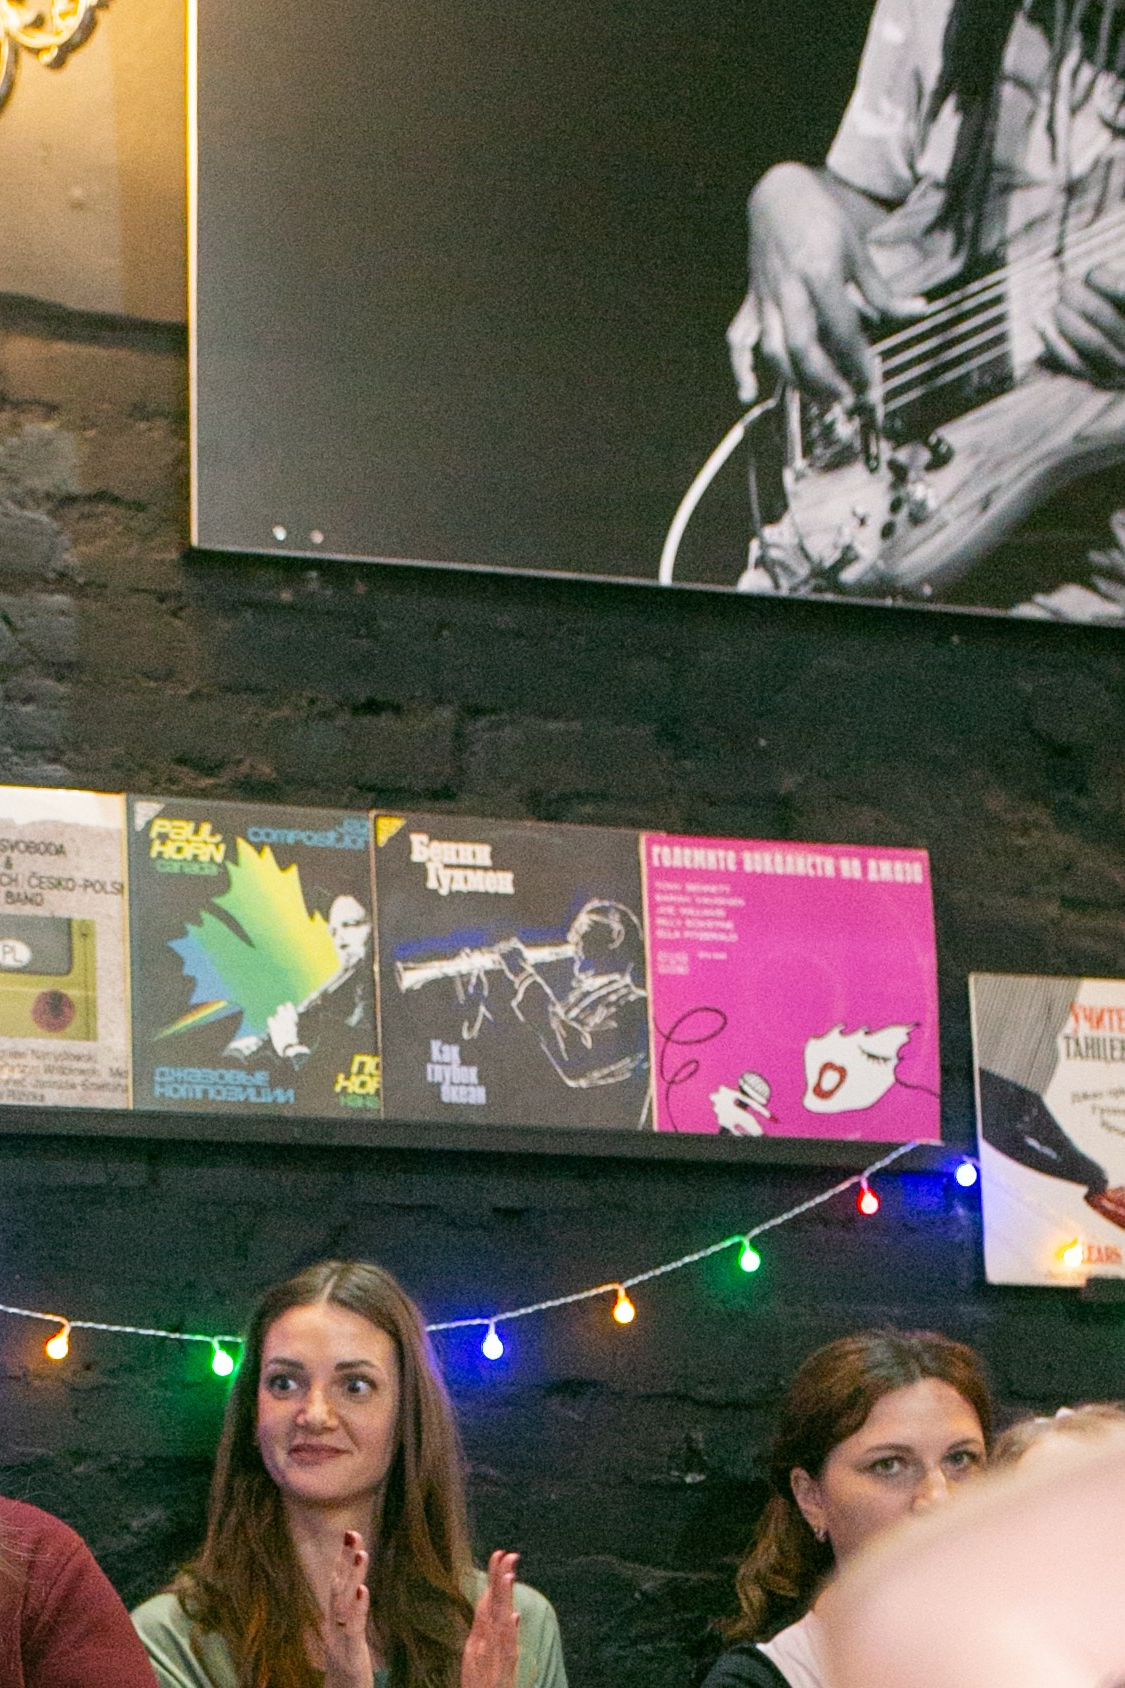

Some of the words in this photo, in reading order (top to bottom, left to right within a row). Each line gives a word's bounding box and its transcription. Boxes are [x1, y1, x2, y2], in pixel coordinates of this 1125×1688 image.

[149, 838, 226, 864] HORN
[409, 832, 492, 866] Бенни
[5, 890, 44, 907] BAND
[2, 944, 23, 963] PL
